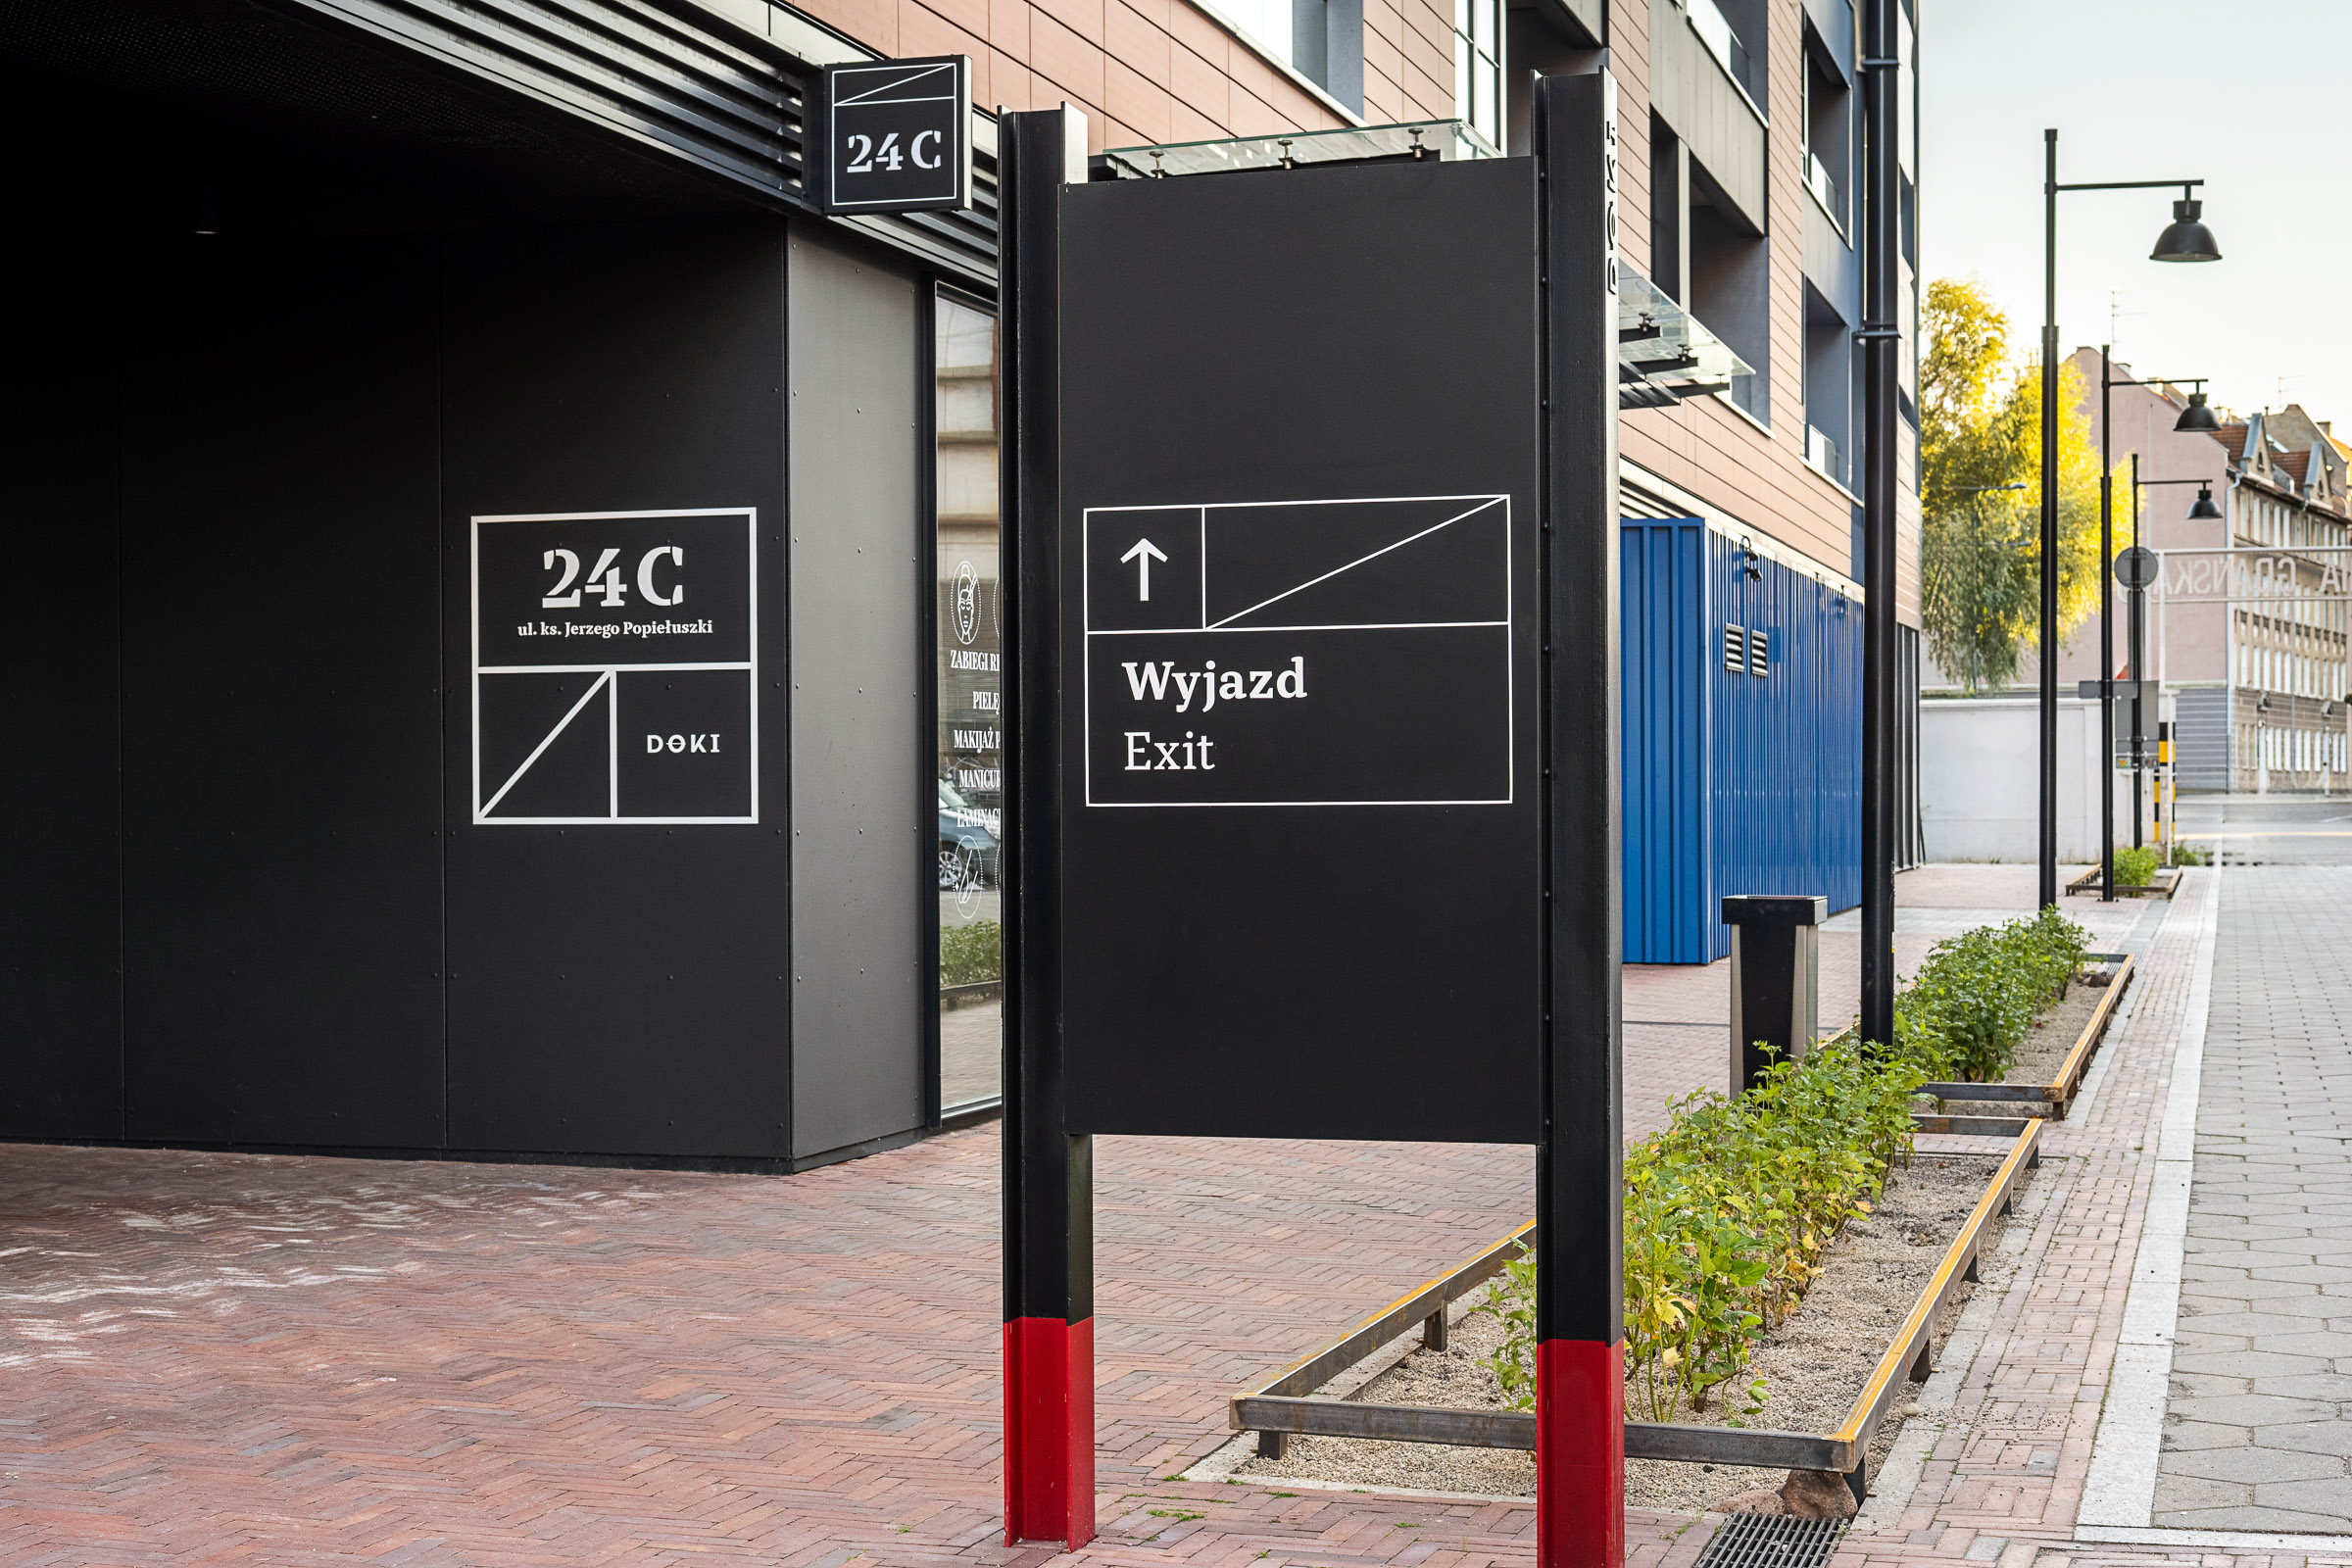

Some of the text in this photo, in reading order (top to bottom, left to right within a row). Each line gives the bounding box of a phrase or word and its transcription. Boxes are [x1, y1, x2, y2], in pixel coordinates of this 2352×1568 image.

[516, 618, 713, 639] ul. ks. Jerzego Popiełuszki
[951, 649, 989, 671] ZABIEGI
[1120, 656, 1308, 713] Wyjazd
[647, 733, 720, 754] DOKI
[954, 726, 994, 754] MAKIJAŻ
[1123, 730, 1215, 771] Exit
